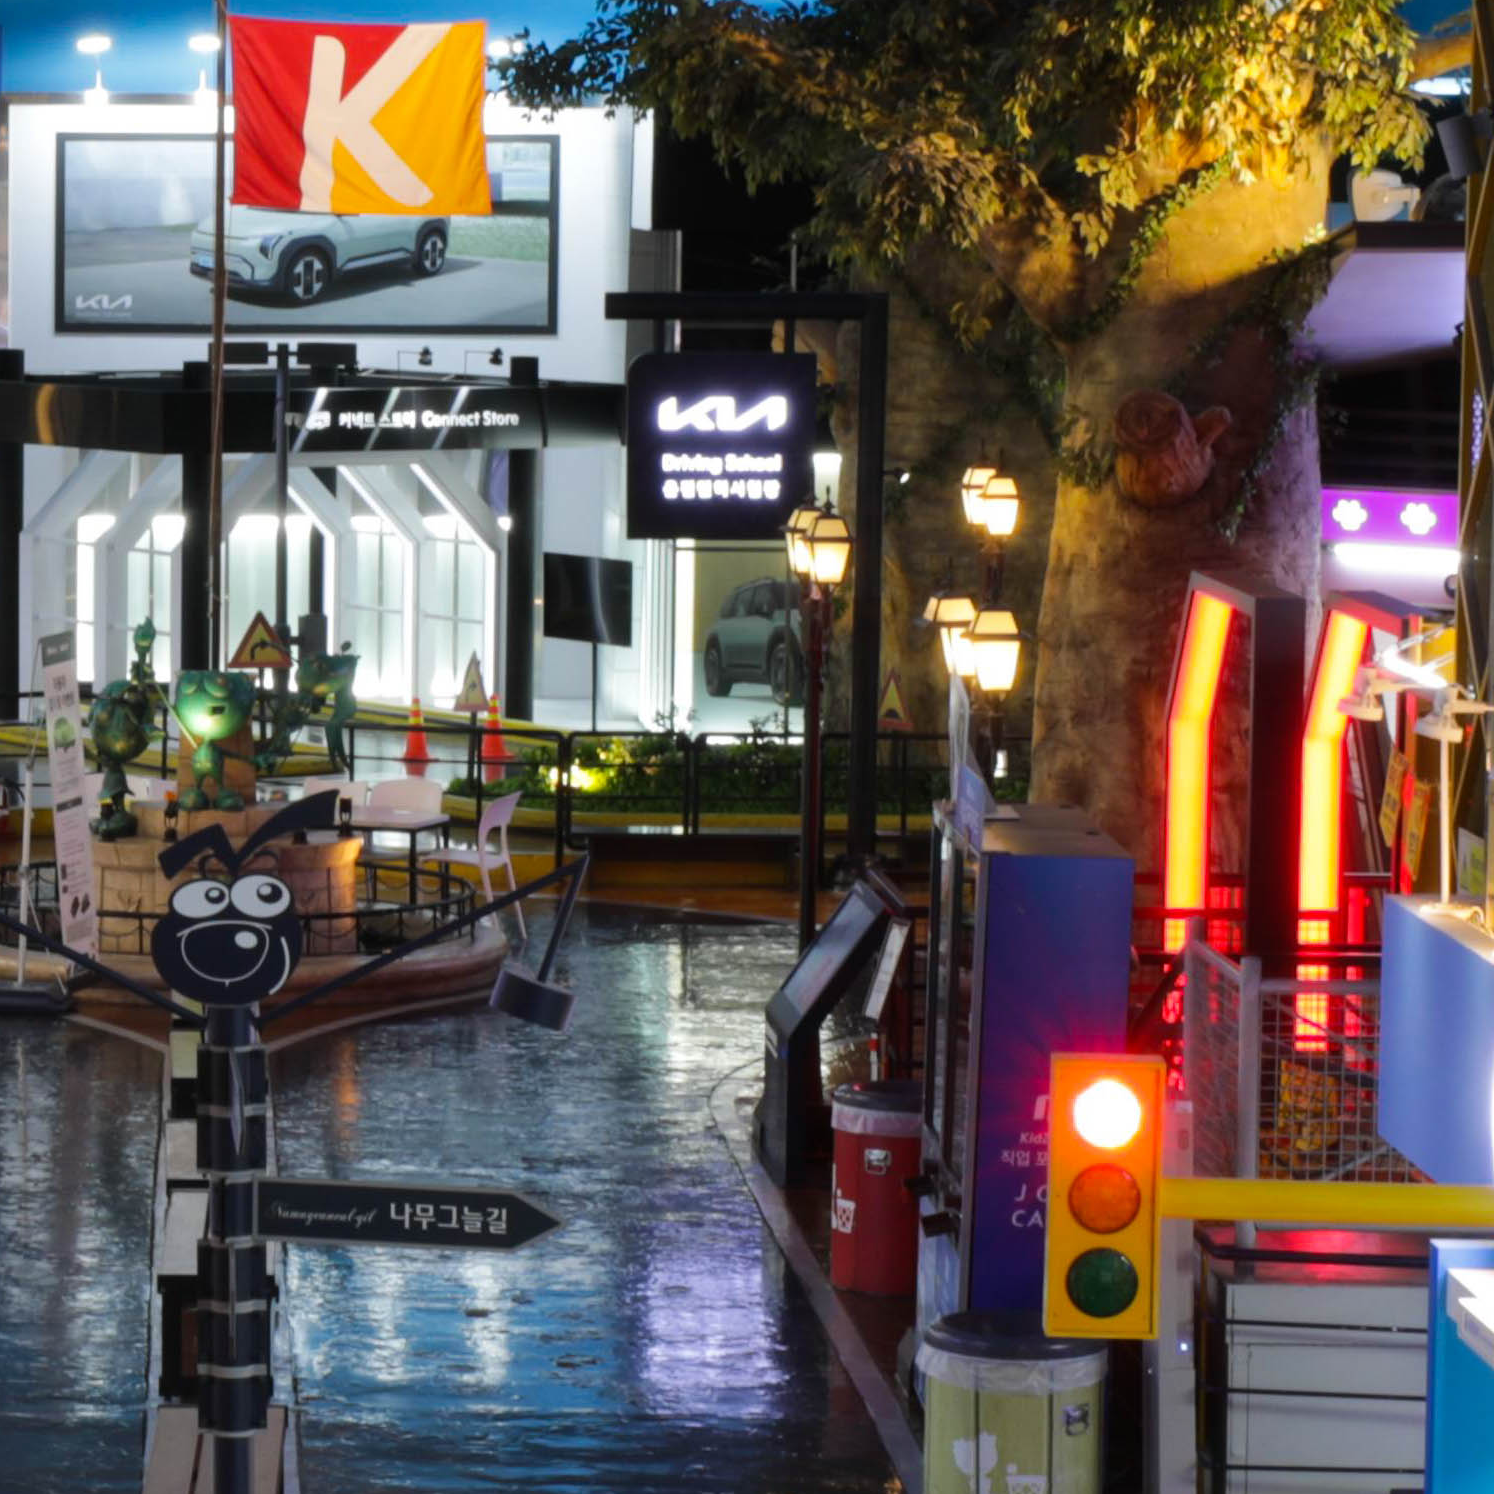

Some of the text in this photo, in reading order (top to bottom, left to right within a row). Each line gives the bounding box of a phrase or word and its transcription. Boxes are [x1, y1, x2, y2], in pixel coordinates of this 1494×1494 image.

[421, 410, 481, 428] Connect
[483, 410, 520, 426] Store
[661, 453, 782, 476] Driving School
[389, 1202, 508, 1235] 나무그늘길
